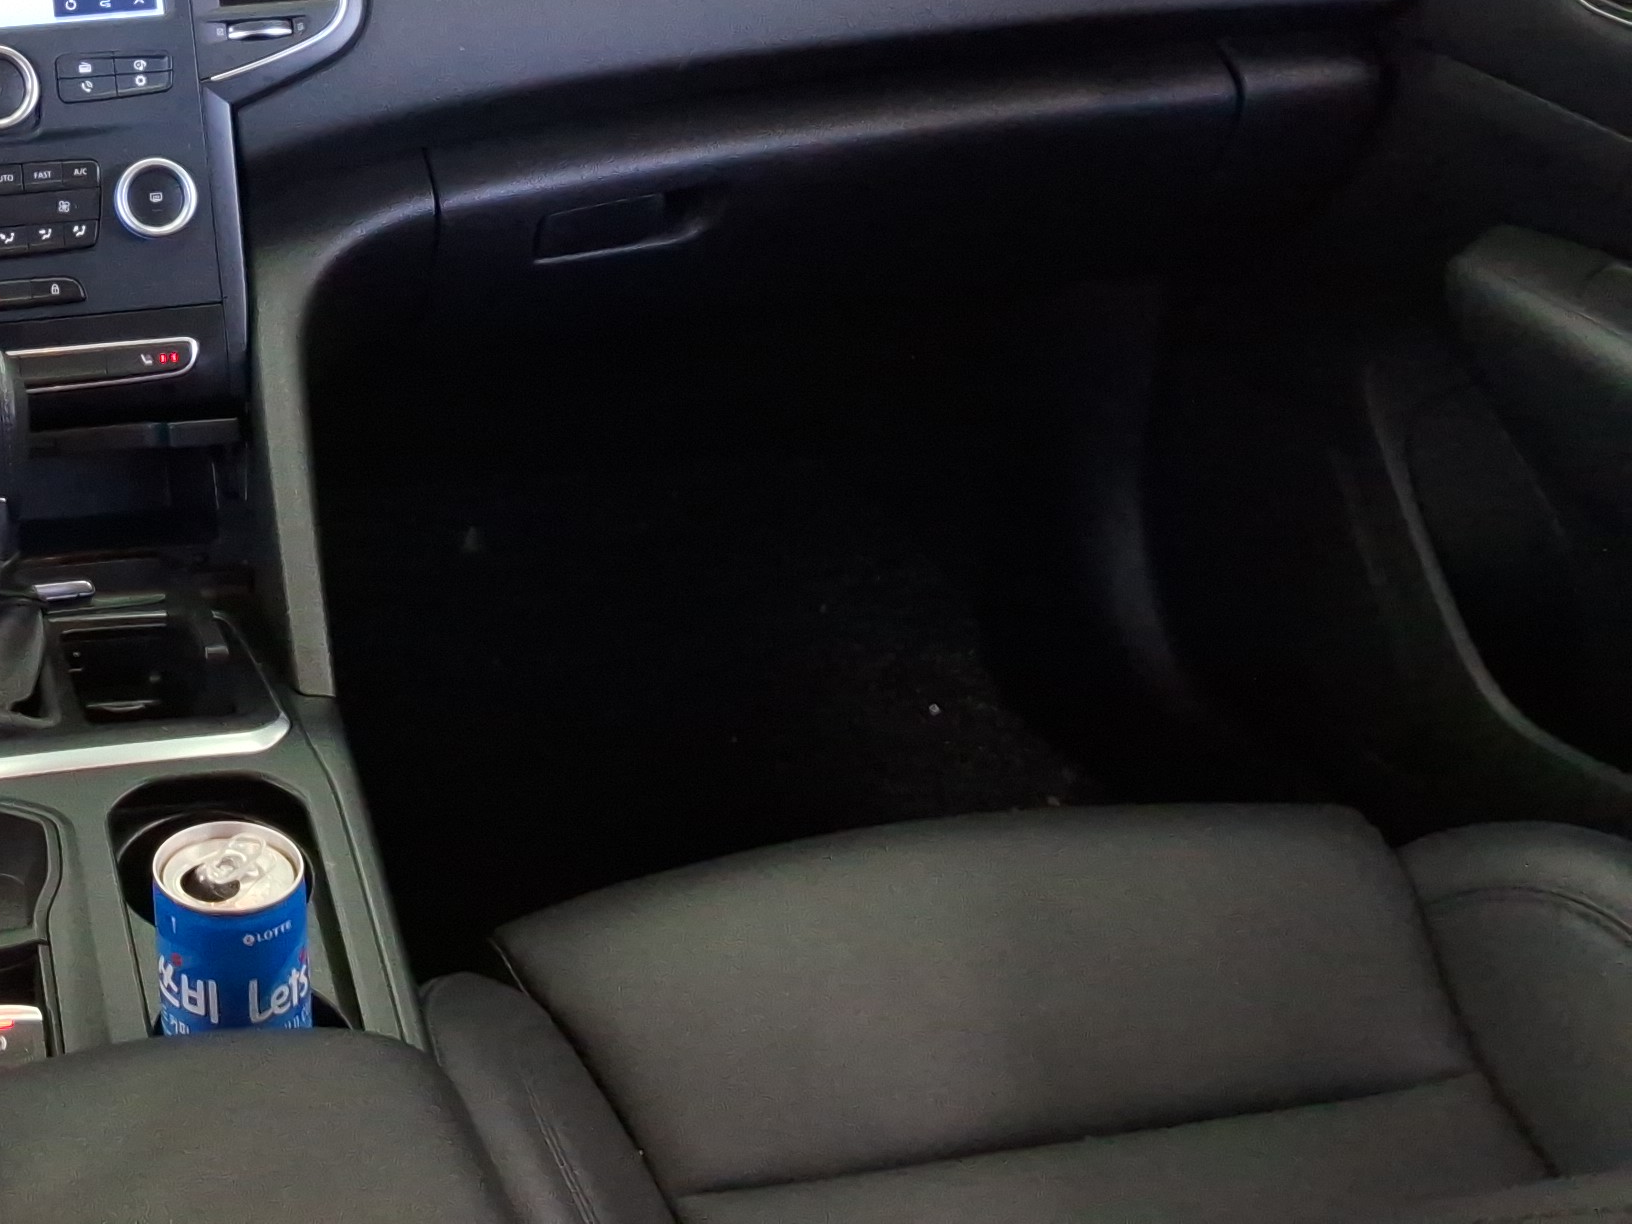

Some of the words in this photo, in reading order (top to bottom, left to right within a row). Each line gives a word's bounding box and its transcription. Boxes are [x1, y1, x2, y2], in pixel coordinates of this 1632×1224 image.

[33, 170, 52, 179] FAST
[73, 167, 88, 176] A/C
[256, 919, 292, 943] LOTTE
